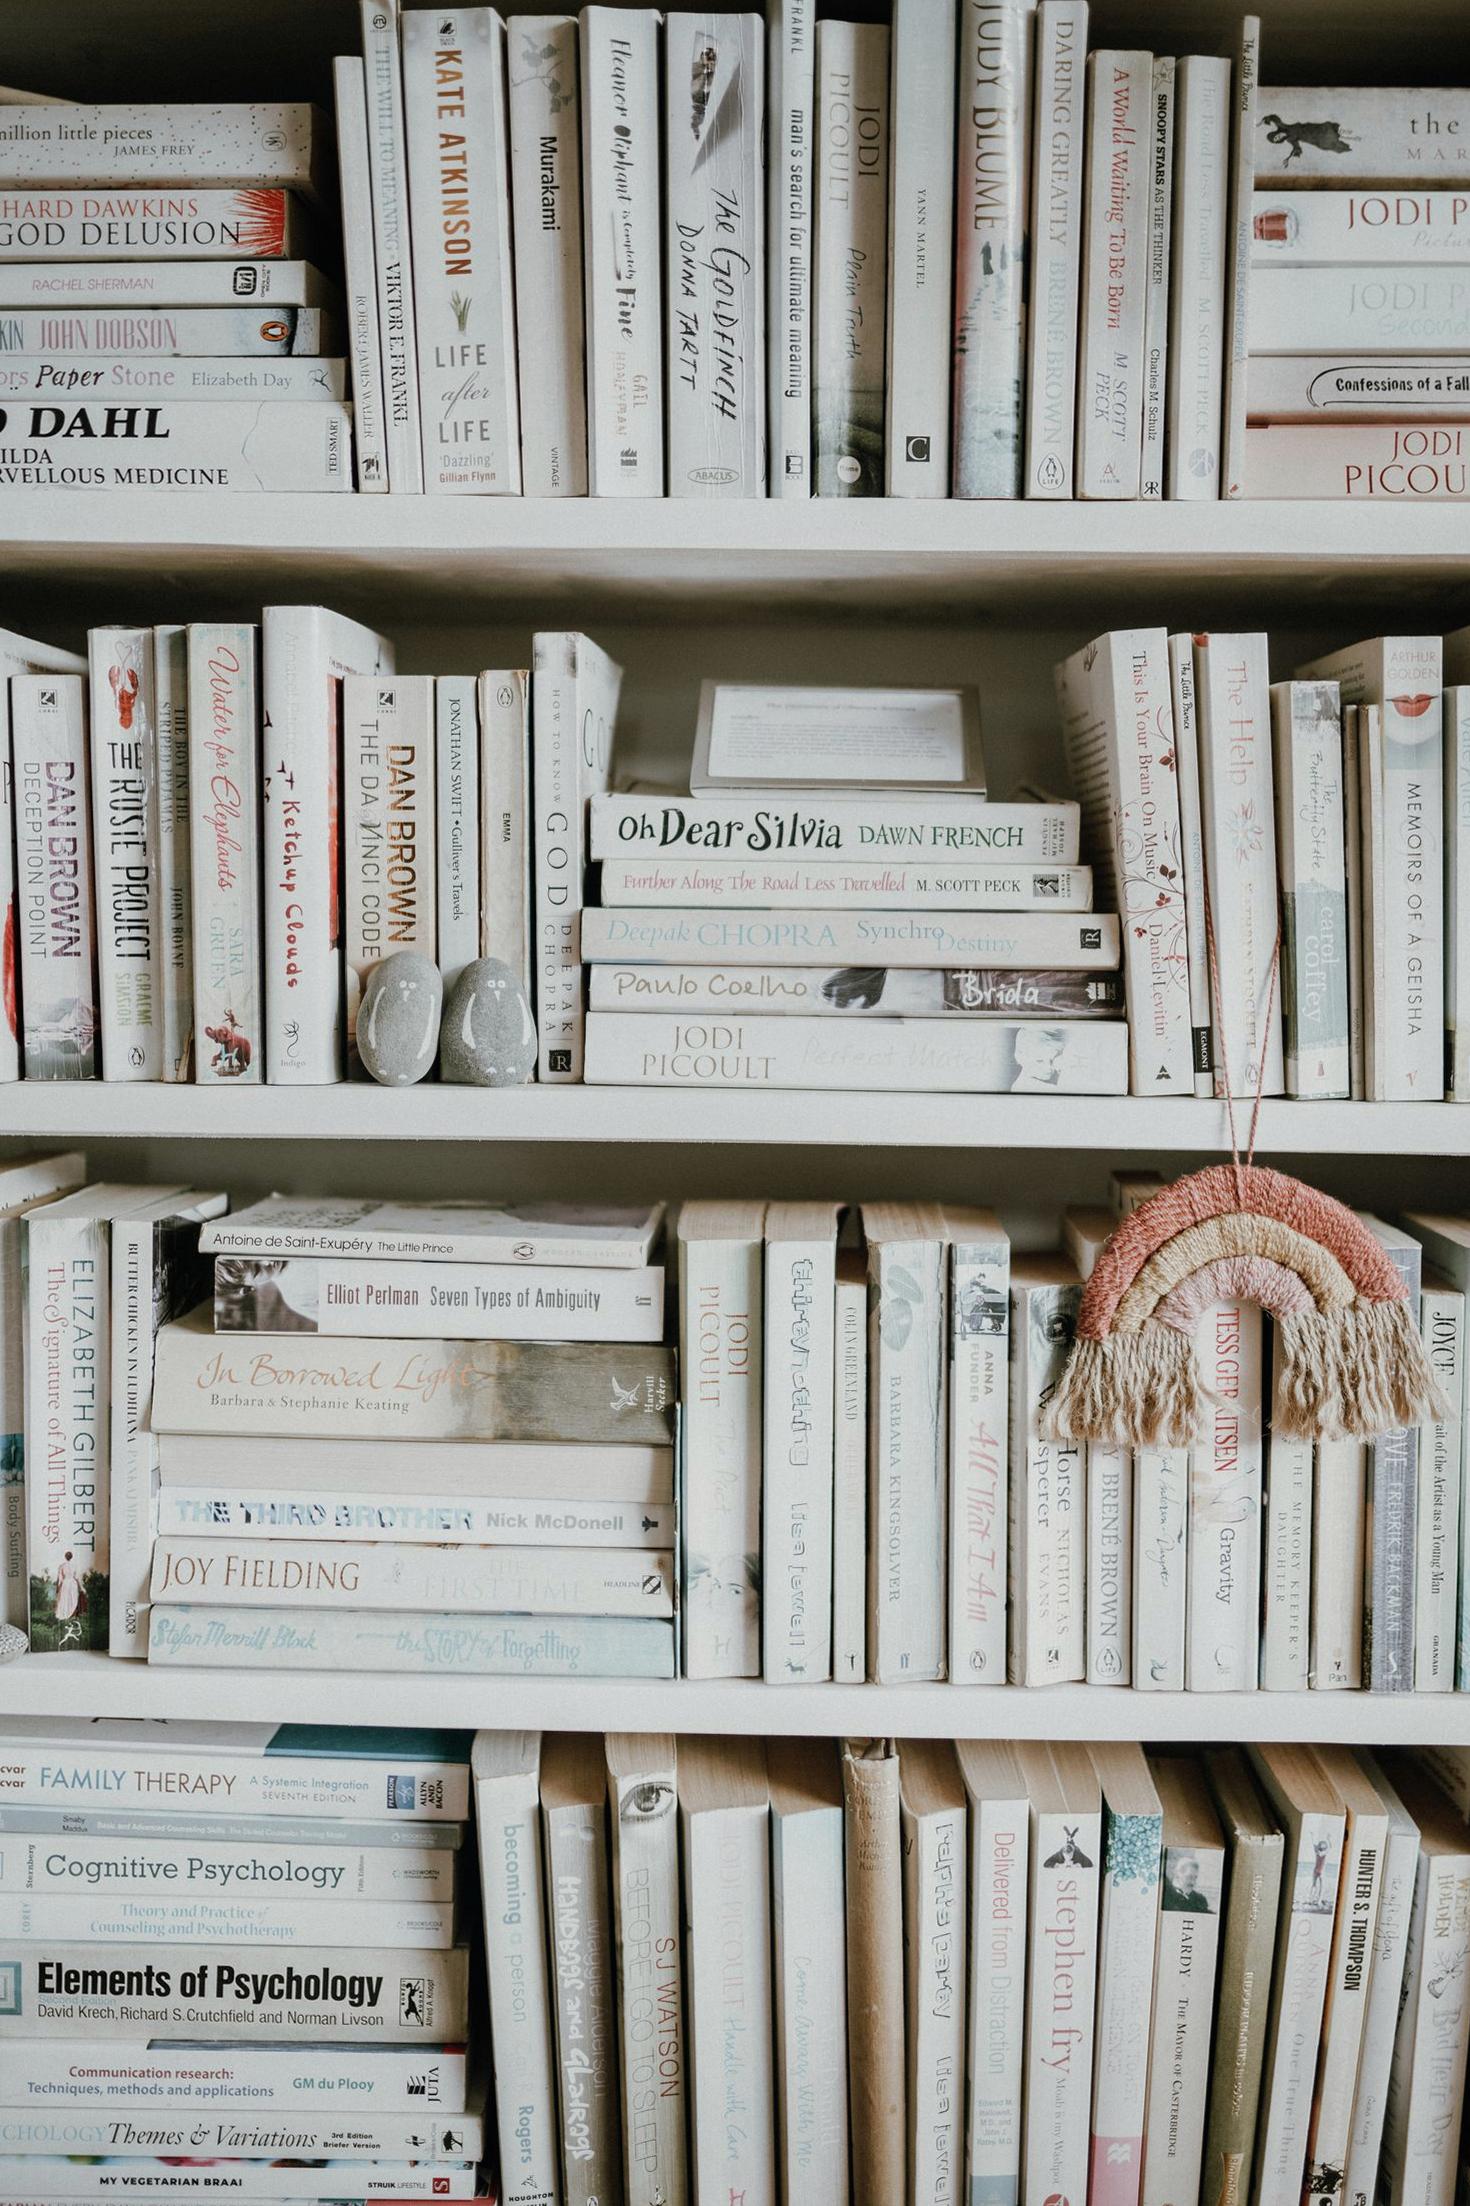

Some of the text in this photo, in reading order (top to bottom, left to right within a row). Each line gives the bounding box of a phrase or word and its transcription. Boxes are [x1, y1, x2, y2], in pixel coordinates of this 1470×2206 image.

[855, 105, 880, 176] JODI
[972, 3, 1016, 231] JUDY BLUME
[1048, 21, 1074, 247] DARING GREATLY
[114, 146, 194, 156] JAMES FREY
[435, 51, 473, 276] KATE ATKINSON
[828, 73, 850, 209] PICOULT
[539, 136, 559, 231] Murakami
[1152, 94, 1168, 284] SNOOPY STARS AS THE THINKER
[83, 199, 198, 218] DAWKINS
[712, 190, 740, 233] The
[82, 222, 240, 246] DELUSION
[784, 110, 807, 398] man's search for ultimate meaning
[916, 188, 927, 288] YANN MARTEL
[676, 220, 704, 390] DONNA TARTT
[40, 318, 177, 349] JOHN DOBSON
[386, 263, 408, 426] VIKTOR E. FRANKL
[436, 344, 488, 367] LIFE
[35, 365, 175, 390] Paper Stone
[192, 372, 292, 390] Elizabeth Day
[1149, 349, 1161, 389] Charles
[1336, 377, 1442, 392] Confessions of a
[440, 371, 490, 418] after
[29, 408, 170, 438] DAHL
[439, 420, 491, 444] LIFE
[1147, 406, 1158, 440] Schulz
[115, 469, 228, 485] MEDICINE
[550, 447, 560, 487] VINTAGE
[107, 742, 142, 768] THE
[448, 698, 463, 772] JONATHAN
[202, 647, 241, 892] Water for Elephants
[450, 776, 462, 817] SWIFT
[360, 720, 383, 958] THE DA VINCI CODE
[386, 745, 417, 942] DAN BROWN
[502, 812, 512, 842] EMMA
[618, 808, 842, 851] Oh Dear Silvia
[858, 824, 1023, 851] DAWN FRENCH
[23, 762, 47, 959] DECEPTION POINT
[45, 761, 82, 957] DAN BROWN
[112, 866, 150, 960] PROJECT
[281, 800, 303, 988] Ketchup Clouds
[451, 884, 465, 921] Travels
[1407, 782, 1422, 1037] MEMOIRS OF A GEISHA
[613, 972, 807, 997] Paulo Coelho
[1199, 1030, 1209, 1069] EGMONT
[213, 1233, 372, 1253] Antoine de Saint-Exupéry
[327, 1284, 600, 1311] Elliot Perlman Seven Types of Ambiguity
[699, 1286, 720, 1407] PICOULT
[725, 1313, 750, 1376] JODI
[1215, 1308, 1240, 1355] TESS
[42, 1262, 73, 1543] The Signature of All Things
[72, 1260, 96, 1552] ELIZABETH GILBERT
[210, 1394, 409, 1414] Barbara & Stephanie Keating
[888, 1375, 902, 1602] BARBARA KINGSOLVER
[486, 1512, 624, 1531] Nick McDonell
[161, 1554, 359, 1592] JOY FIELDING
[1100, 1474, 1122, 1637] BRENÉ BROWN
[1215, 1528, 1234, 1604] Gravity
[126, 1601, 135, 1634] PICADOR
[40, 1767, 236, 1795] FAMILY THERAPY
[45, 1854, 345, 1888] Cognitive Psychology
[1344, 1849, 1377, 1991] HUNTER S. THOMPSON
[1180, 1919, 1194, 1978] HARDY
[38, 1961, 383, 2008] Elements of Psychology
[504, 1824, 536, 2163] becoming Rogers
[1041, 1880, 1084, 2075] stephen fry
[38, 2005, 384, 2026] David Krech, Richard S. Crutchfield and Norman Livson
[655, 1937, 679, 2098] SJ WATSON
[70, 2066, 234, 2080] Communication research:
[100, 2177, 242, 2187] MY VEGETARIAN BRAAI
